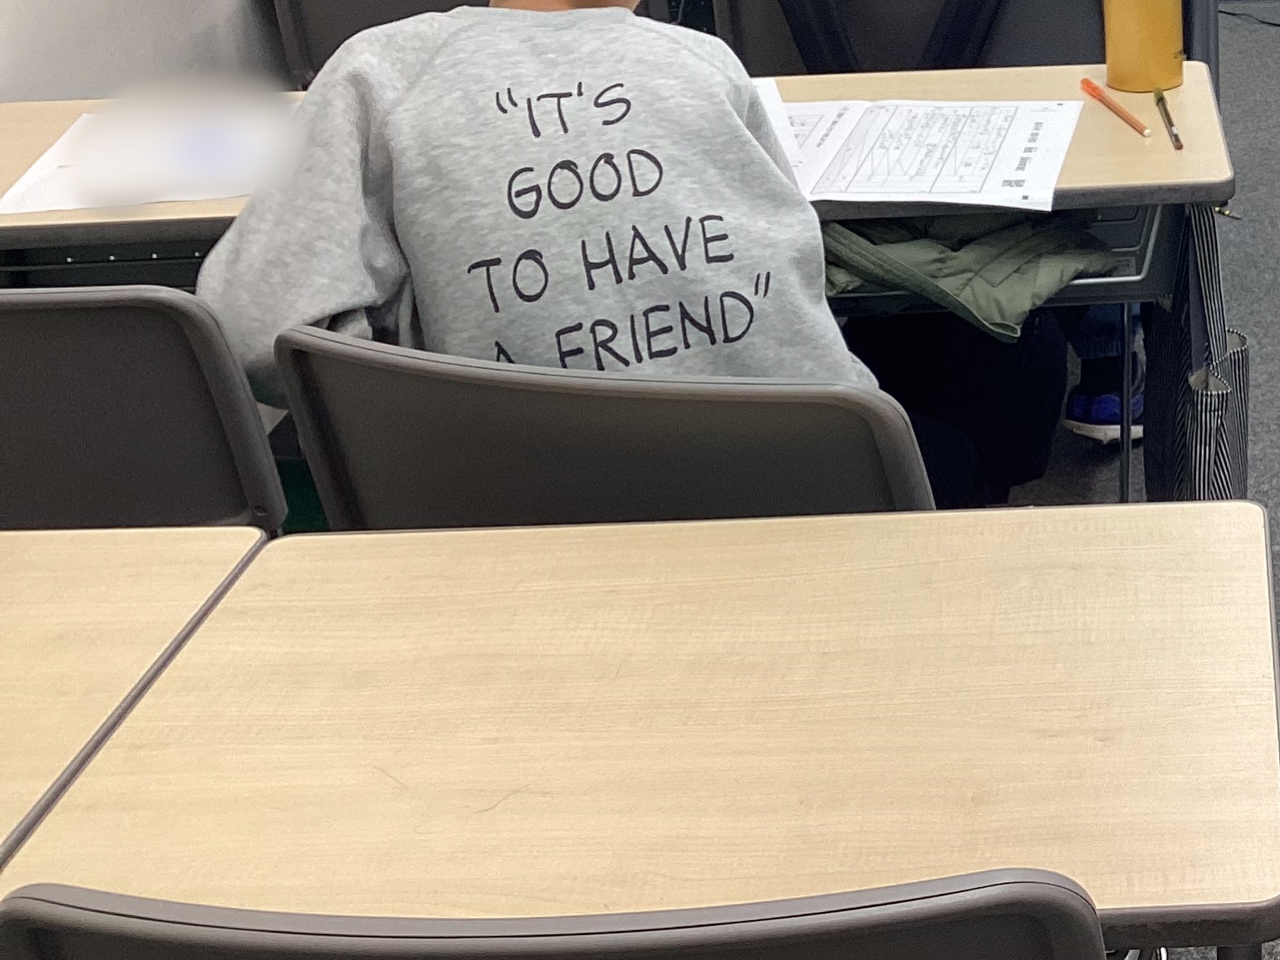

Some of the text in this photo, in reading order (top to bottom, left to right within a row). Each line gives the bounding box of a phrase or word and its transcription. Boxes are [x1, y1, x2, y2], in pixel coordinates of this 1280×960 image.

[507, 149, 663, 219] GOOD
[468, 215, 734, 313] TO HAVE
[555, 272, 770, 371] FRIEND"
